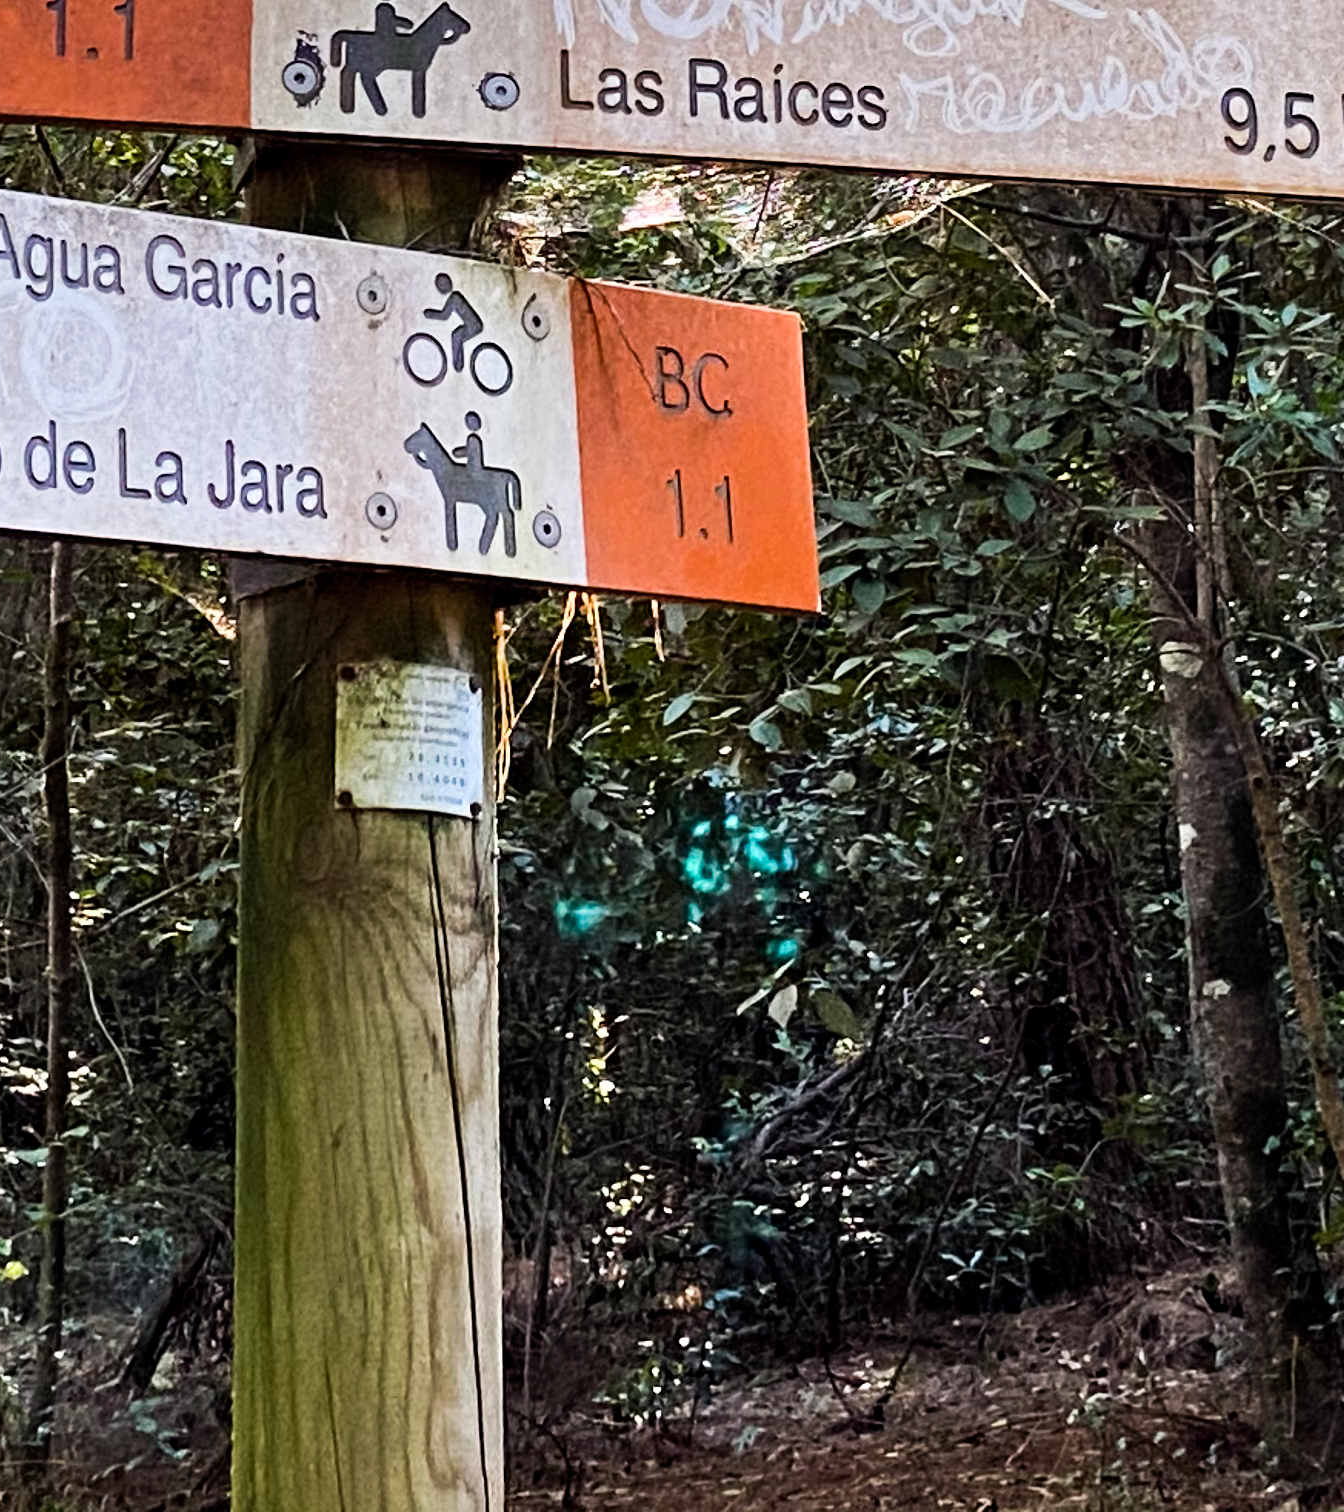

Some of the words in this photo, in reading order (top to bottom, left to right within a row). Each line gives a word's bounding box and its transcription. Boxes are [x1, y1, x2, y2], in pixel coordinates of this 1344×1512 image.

[558, 49, 665, 117] Las
[687, 57, 889, 132] Raíces
[1220, 87, 1321, 162] 9,5
[655, 345, 734, 419] BC
[23, 419, 96, 494] de
[118, 427, 188, 505] La
[206, 439, 328, 519] Jara
[665, 468, 734, 544] 1.1
